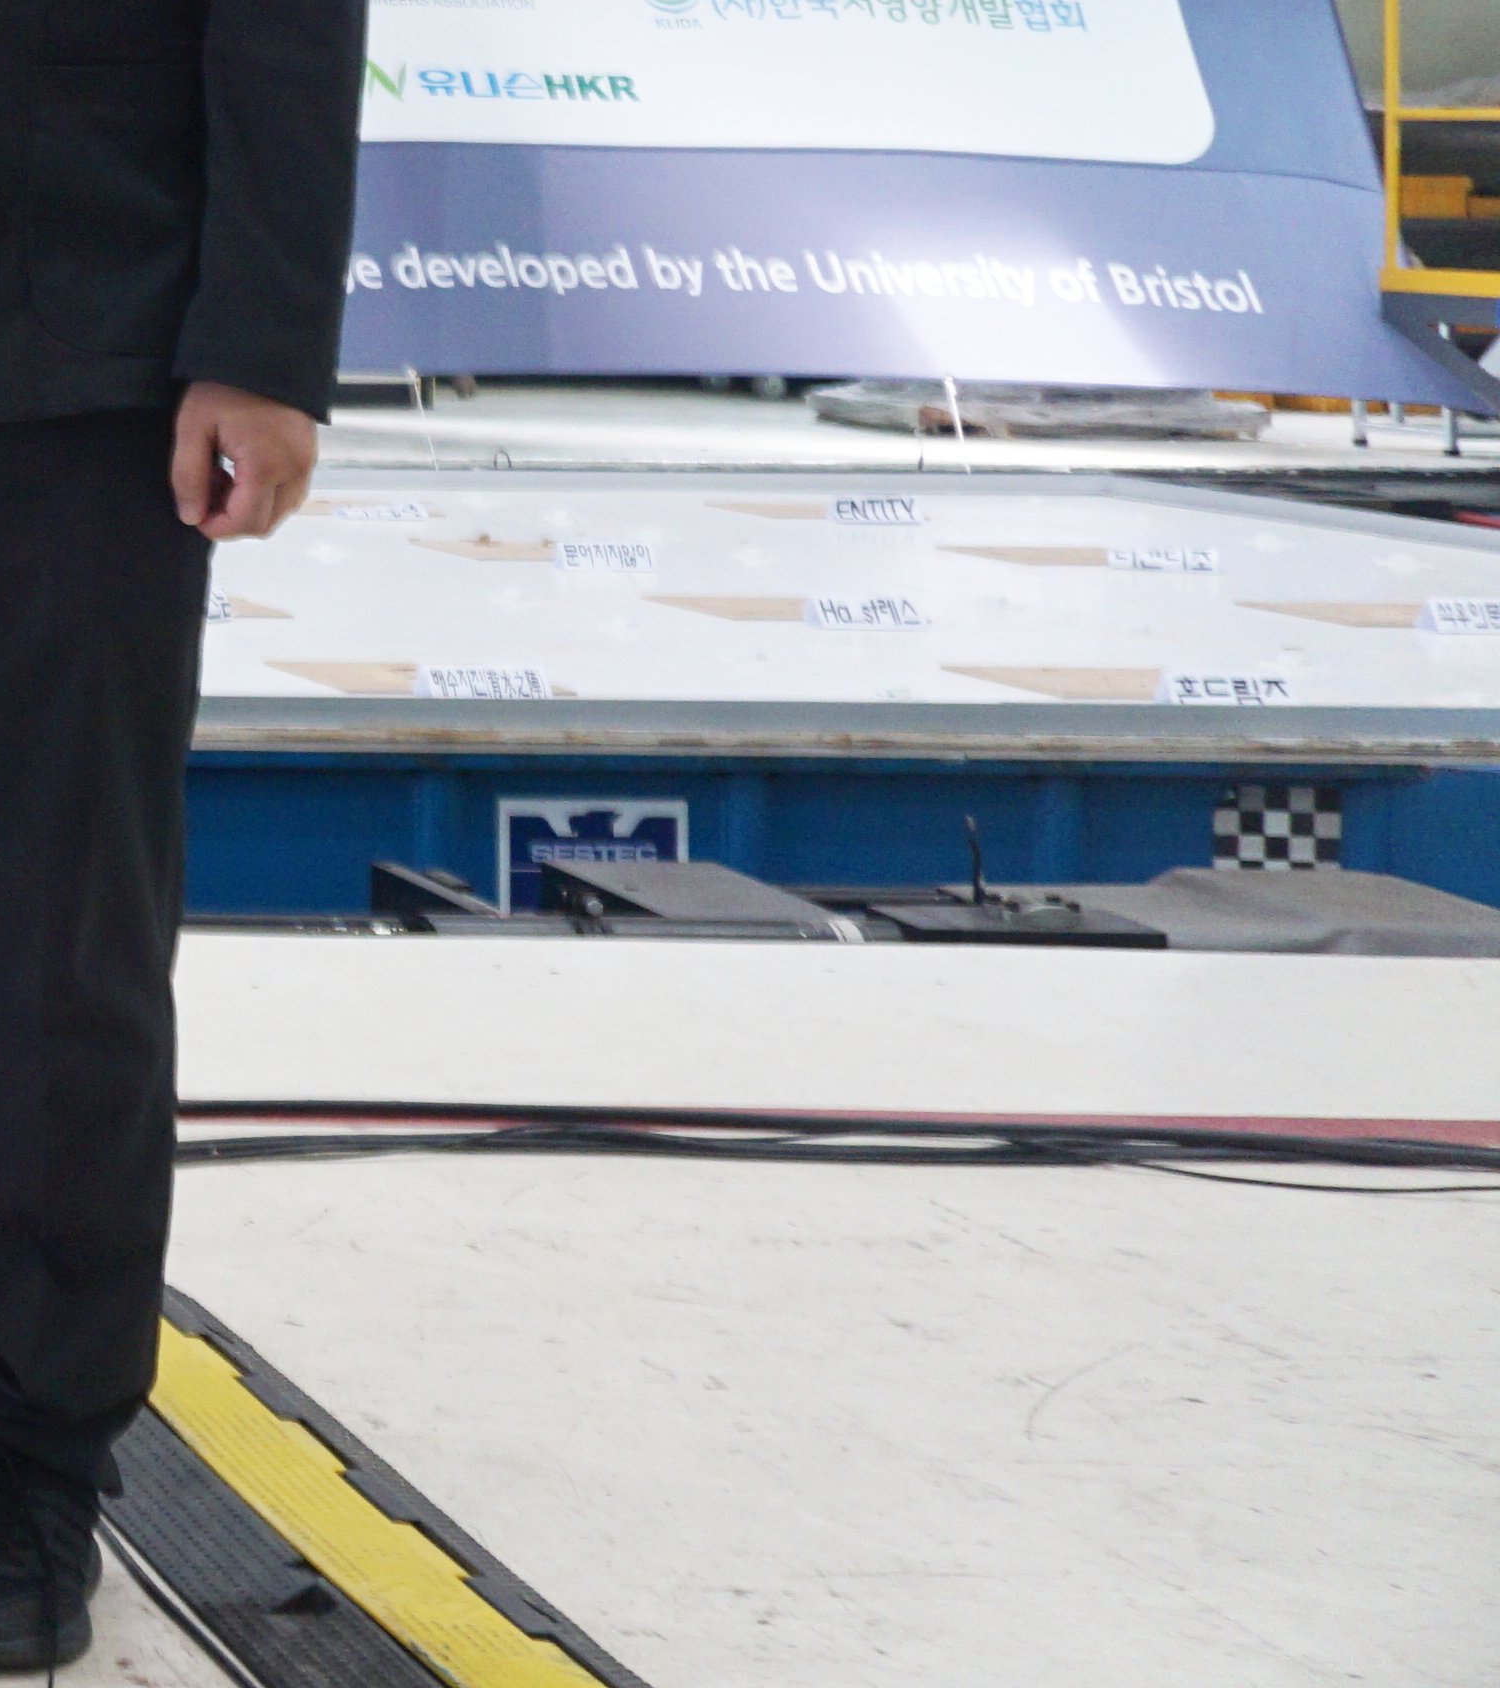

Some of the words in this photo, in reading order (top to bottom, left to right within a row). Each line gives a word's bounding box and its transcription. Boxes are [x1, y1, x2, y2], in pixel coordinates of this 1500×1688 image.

[395, 243, 639, 295] developed
[644, 244, 703, 297] by
[716, 245, 798, 293] the
[803, 249, 1037, 307] University
[1048, 256, 1102, 303] of
[1108, 263, 1266, 314] Bristol
[836, 498, 916, 522] ENTITY
